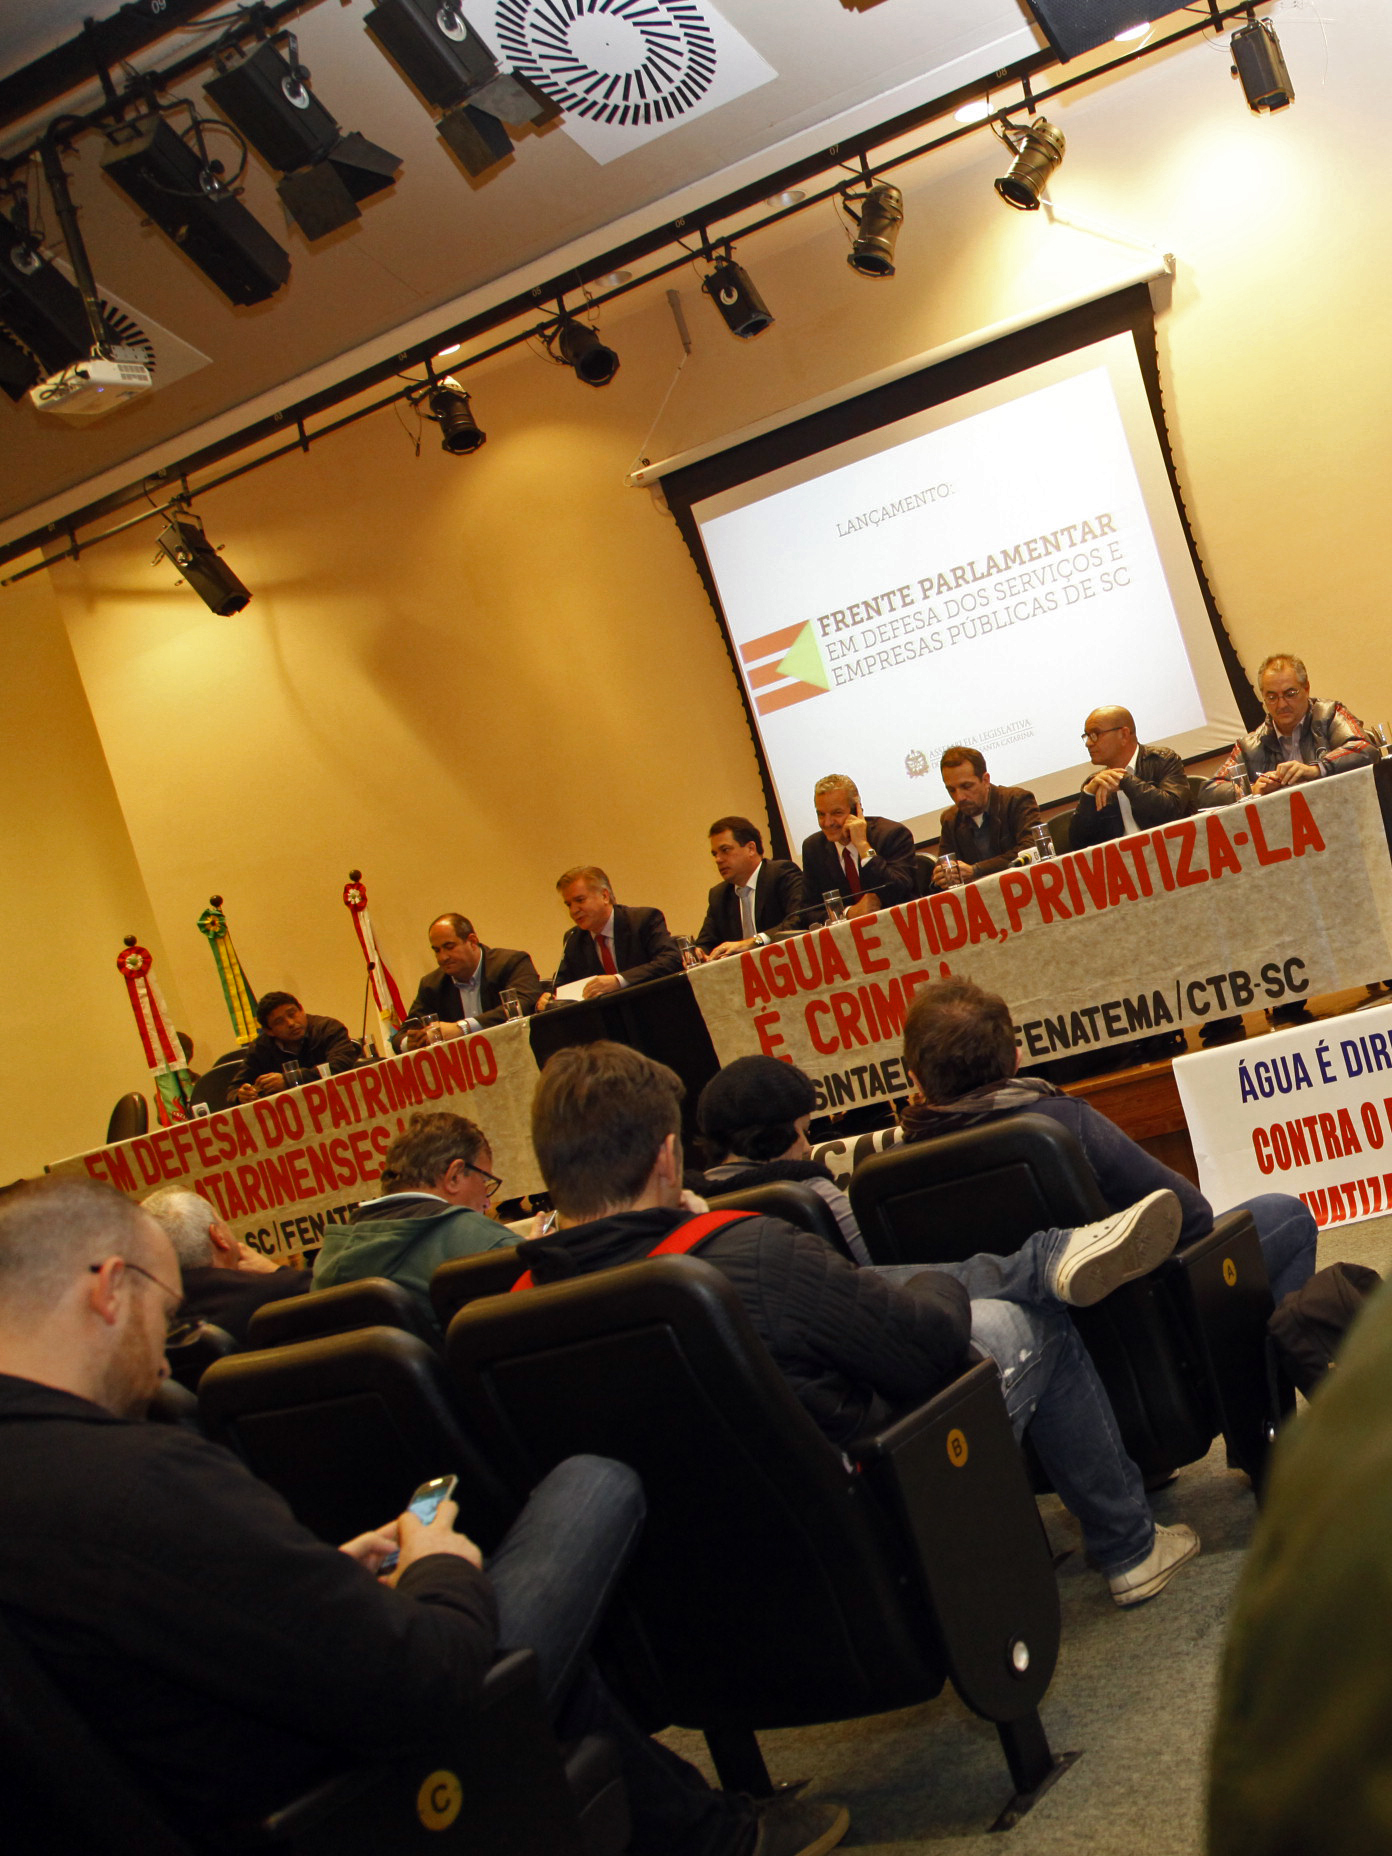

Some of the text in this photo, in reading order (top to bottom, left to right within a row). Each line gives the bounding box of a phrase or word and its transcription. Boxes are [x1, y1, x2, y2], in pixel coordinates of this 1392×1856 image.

[836, 483, 956, 537] LANÇAMENTO:
[817, 513, 1117, 637] FRENTE PARLAMENTAR
[825, 541, 1123, 661] EM DEFESA DOS SERVIÇOS E
[832, 567, 1131, 686] EMPRESAS PÚBLICAS DE SC
[978, 719, 1032, 742] LEGISLATIVA
[740, 927, 850, 1008] AGUA
[850, 914, 890, 975] E
[753, 1004, 793, 1065] É
[1238, 1052, 1313, 1103] ÁGUA
[1315, 1039, 1338, 1084] É
[130, 1106, 258, 1186] DEFESA
[253, 1093, 304, 1149] DO
[301, 1034, 498, 1135] PATRIMONIO
[1251, 1107, 1363, 1175] CONTRA
[1360, 1101, 1384, 1150] O
[1227, 1264, 1235, 1280] A
[951, 1438, 962, 1458] B
[431, 1784, 451, 1814] C
